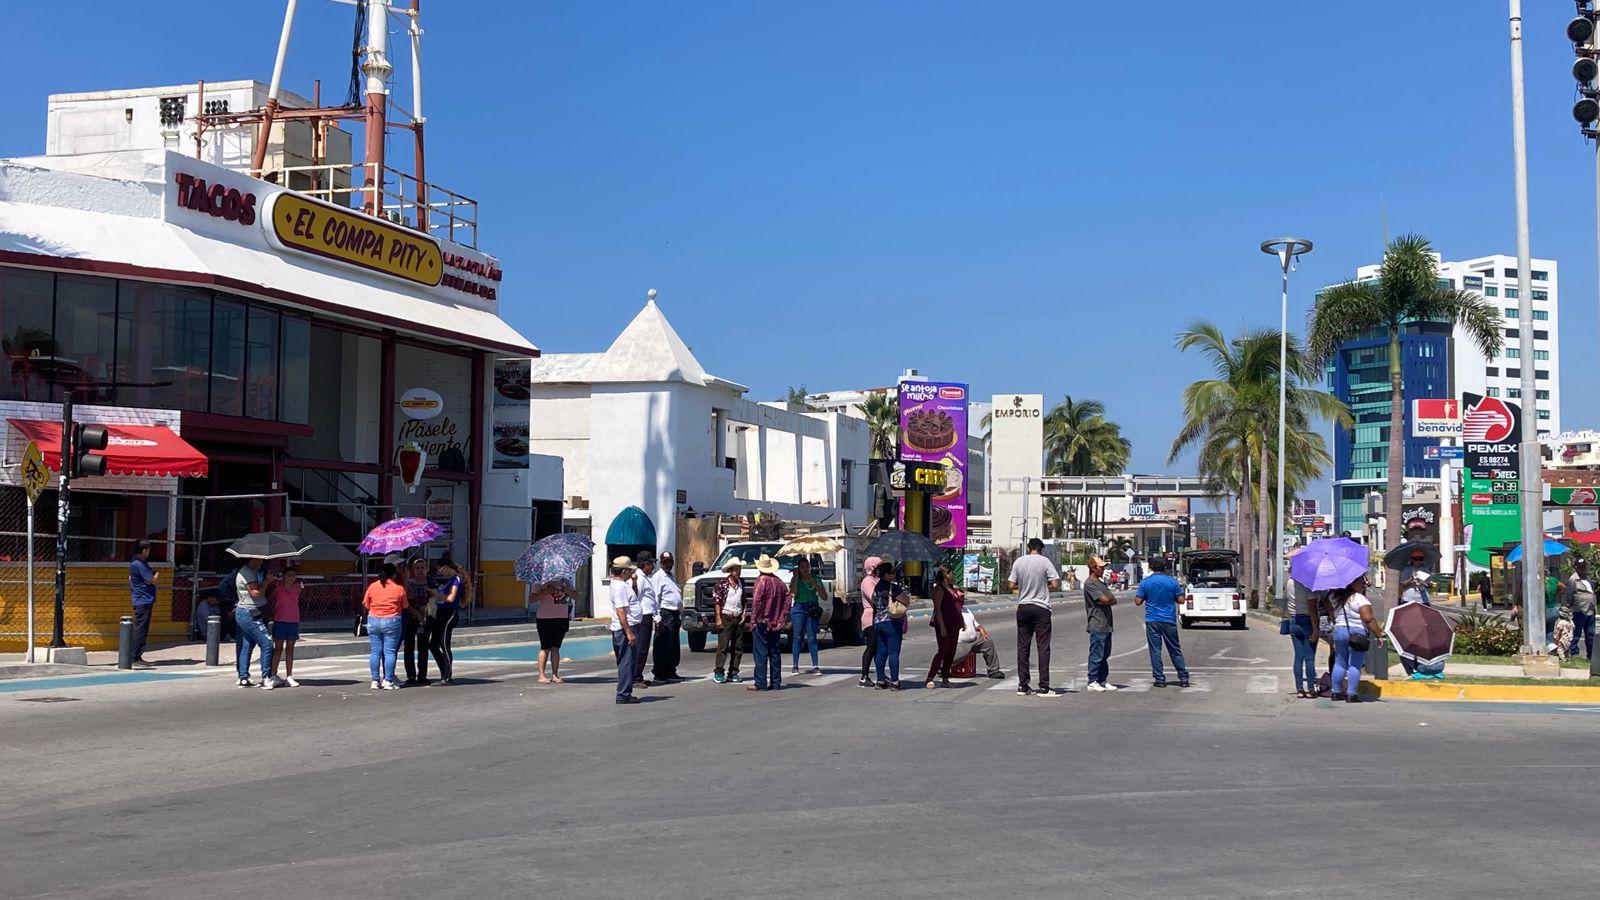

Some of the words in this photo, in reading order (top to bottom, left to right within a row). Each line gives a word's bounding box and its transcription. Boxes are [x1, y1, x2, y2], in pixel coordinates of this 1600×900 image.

[175, 172, 256, 225] TACOS
[294, 208, 315, 239] EL
[322, 217, 385, 261] COMPA
[388, 239, 428, 273] PITY
[901, 383, 910, 393] Se
[910, 384, 937, 393] antoja
[907, 392, 934, 401] mucho
[995, 409, 1039, 418] EMPORIO
[1418, 423, 1463, 432] benavid
[1468, 444, 1517, 452] PEMEX
[1130, 504, 1155, 515] HOTEL
